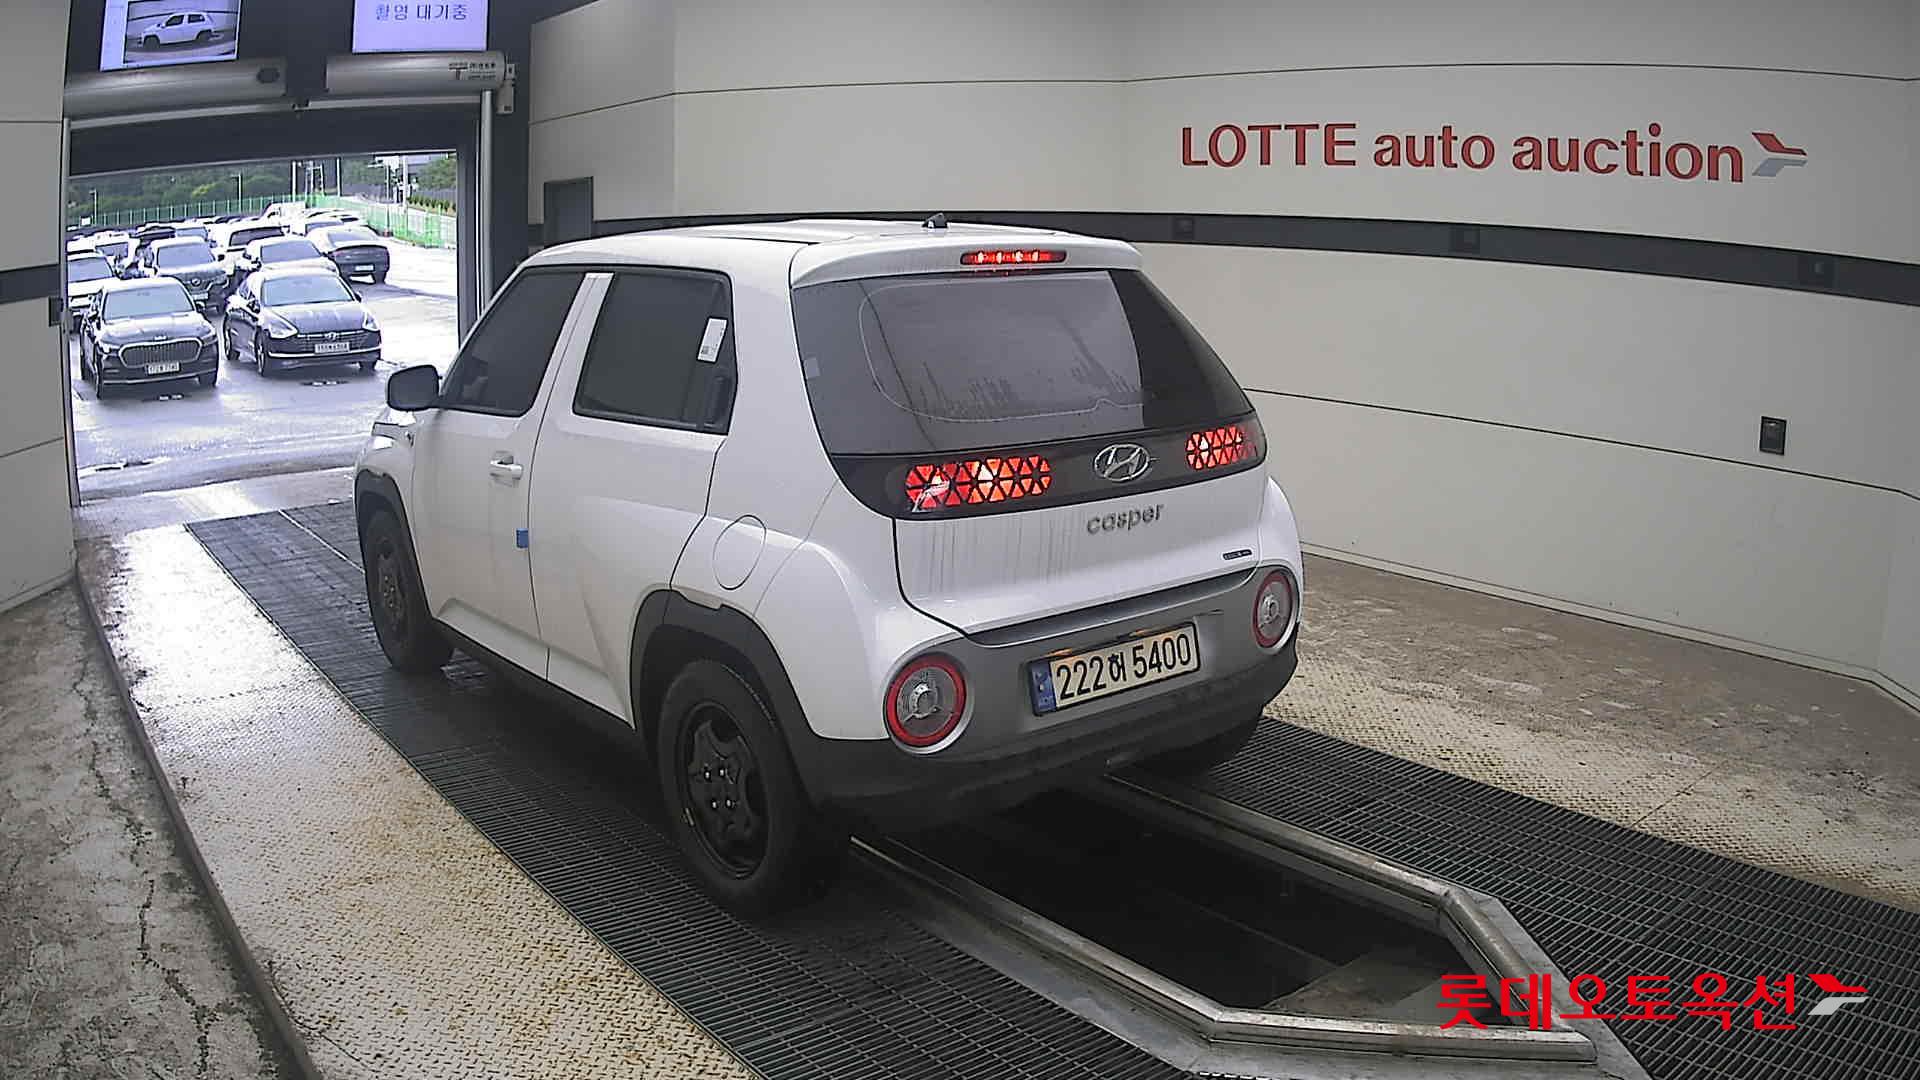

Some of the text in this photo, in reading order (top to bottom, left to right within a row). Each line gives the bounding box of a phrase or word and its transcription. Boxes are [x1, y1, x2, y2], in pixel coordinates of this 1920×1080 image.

[416, 4, 467, 21] 대기중
[1182, 122, 1743, 183] LOTTE auto auction
[1087, 504, 1163, 534] casper
[1132, 634, 1191, 678] 5400
